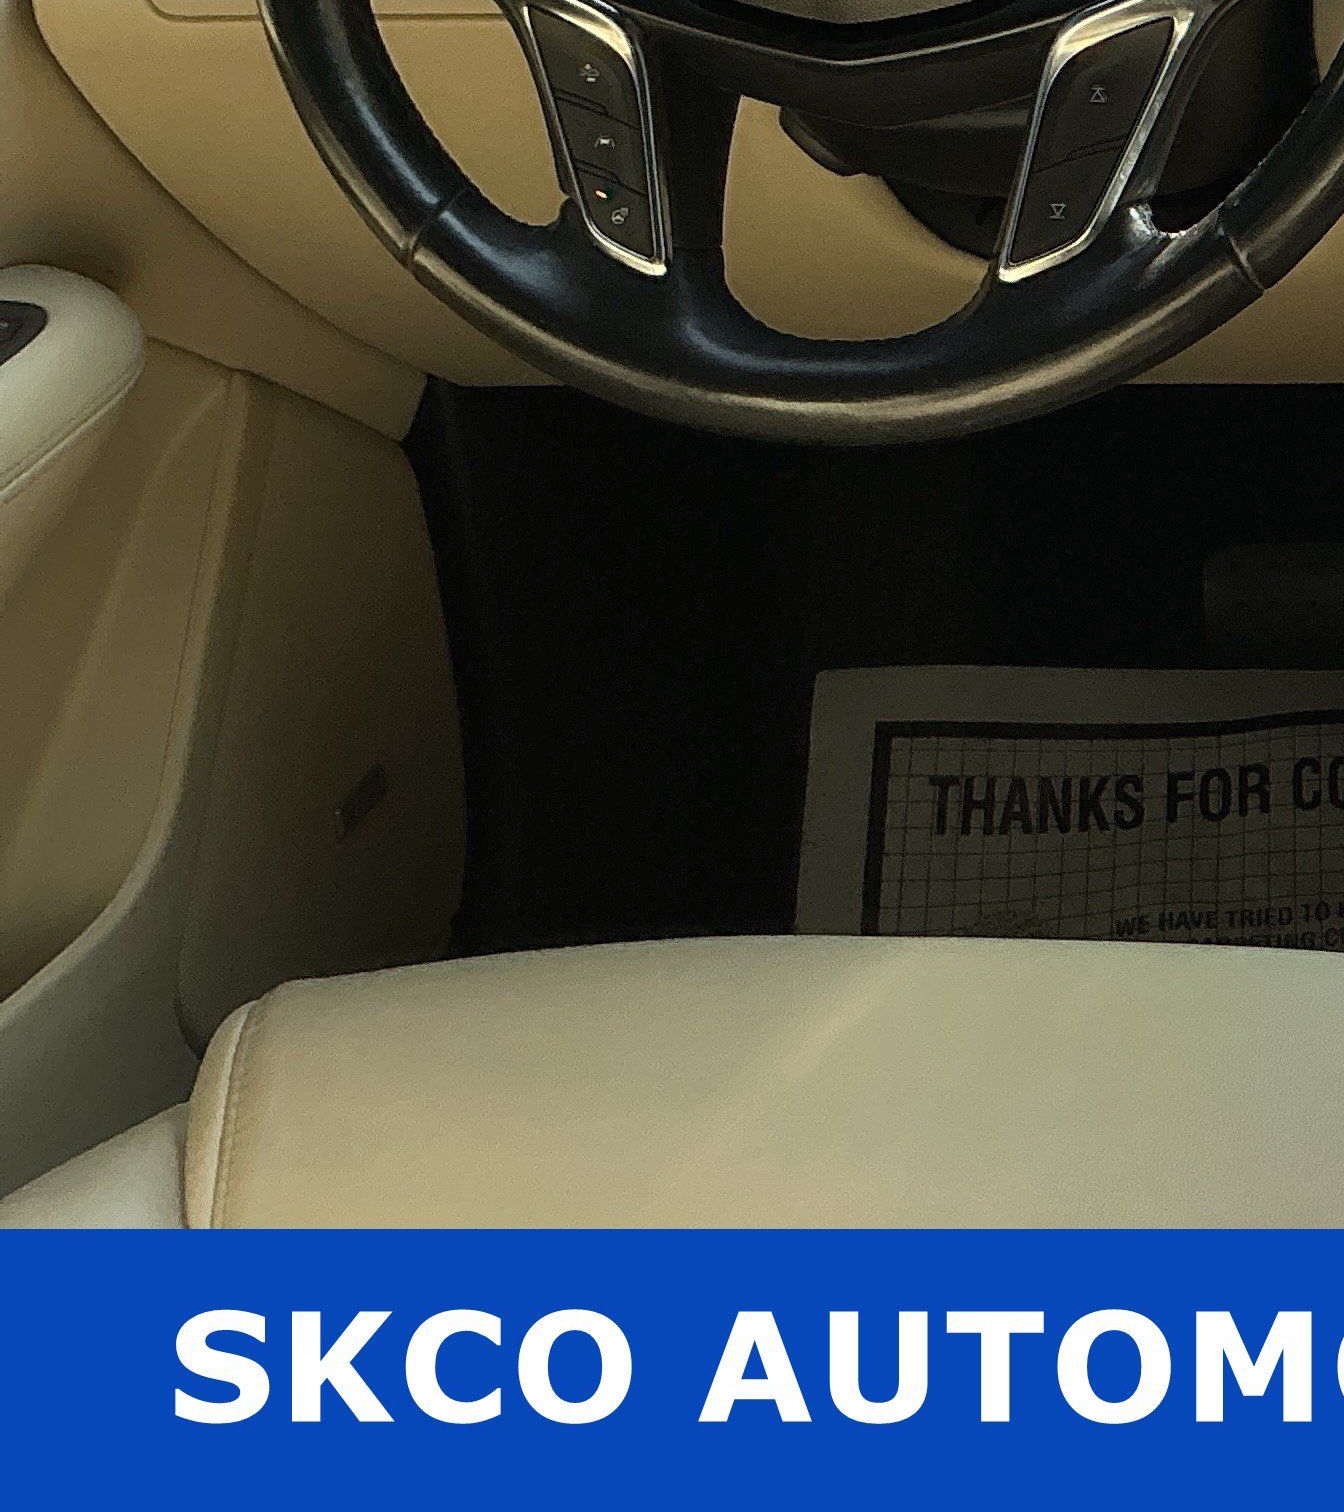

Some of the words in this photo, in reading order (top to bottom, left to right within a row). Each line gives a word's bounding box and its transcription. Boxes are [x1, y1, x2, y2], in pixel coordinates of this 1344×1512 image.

[928, 772, 1147, 836] THANKS
[1164, 760, 1272, 824] FOR
[1115, 915, 1150, 937] WE
[1157, 910, 1218, 932] HAVE
[1224, 905, 1294, 928] TRIED
[1302, 901, 1330, 921] TO
